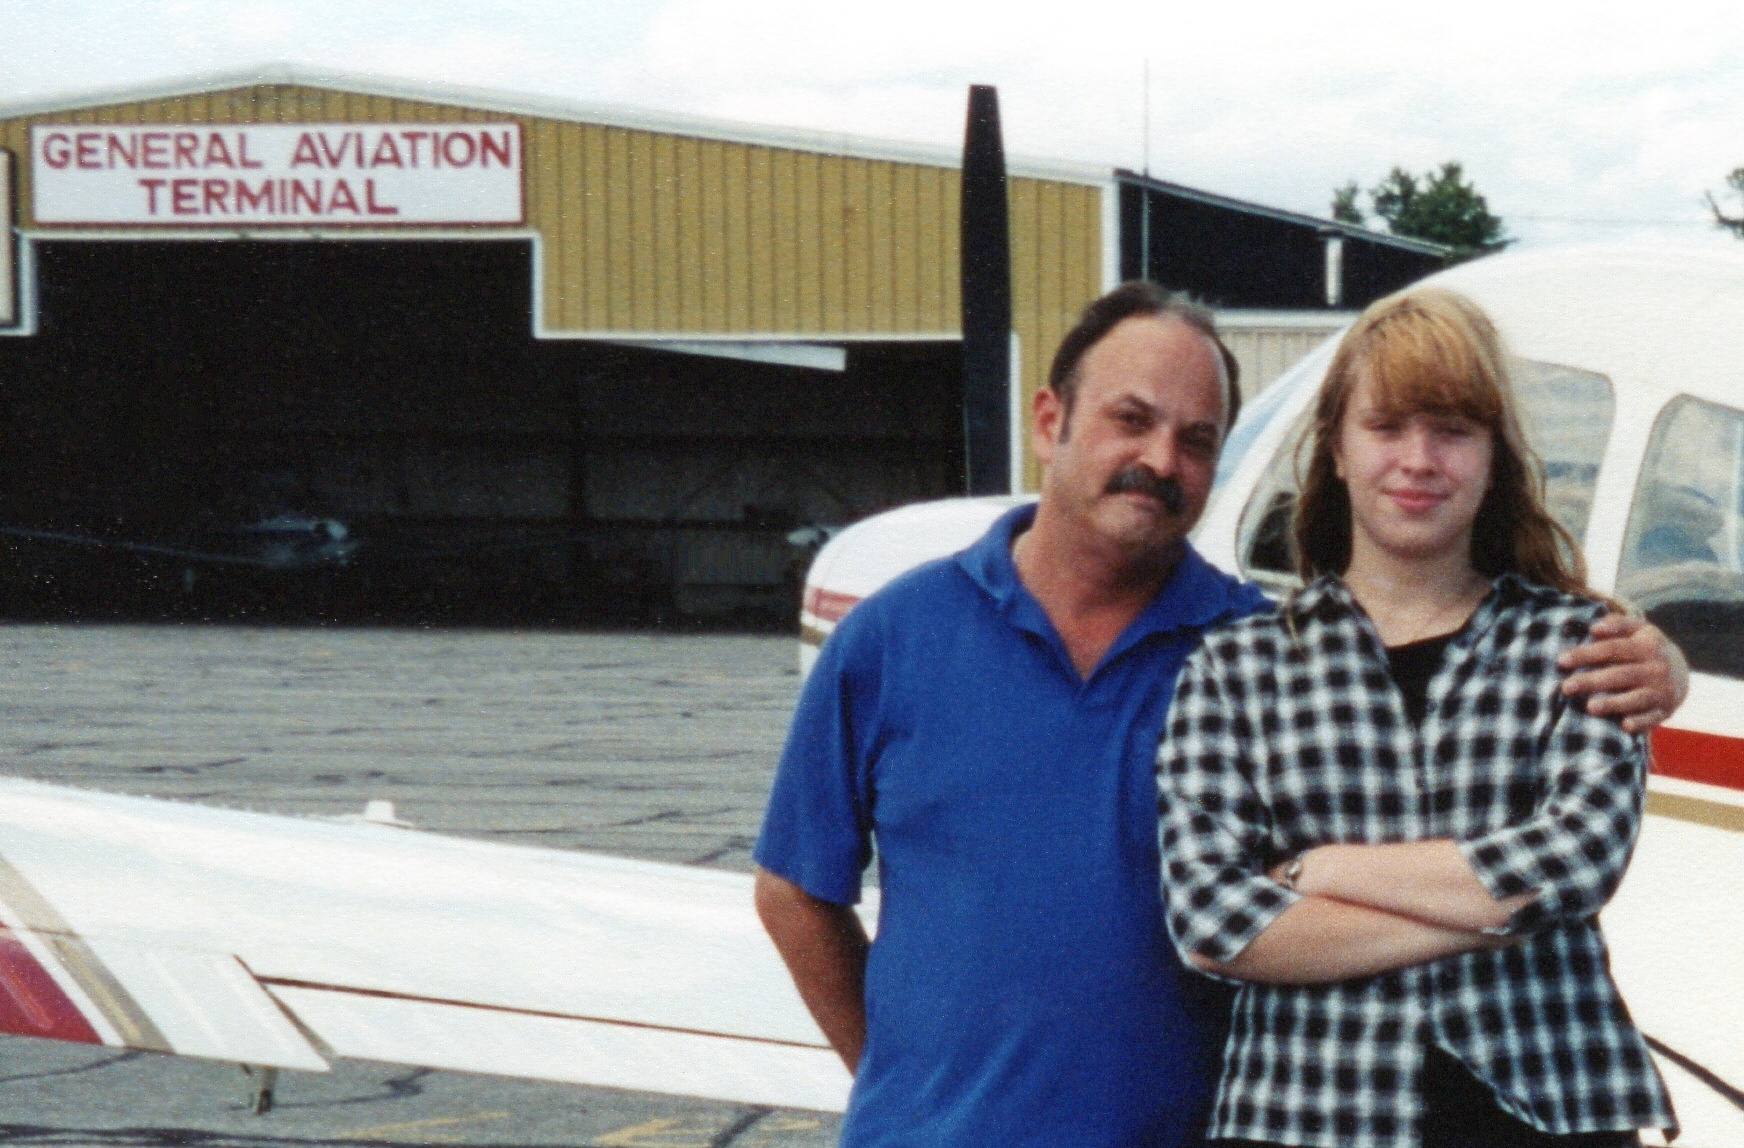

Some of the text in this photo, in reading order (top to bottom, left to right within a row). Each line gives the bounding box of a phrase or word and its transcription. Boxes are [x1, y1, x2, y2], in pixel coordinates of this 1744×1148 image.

[42, 130, 512, 170] GENERAL AVIATION
[138, 178, 399, 216] TERMINAL
